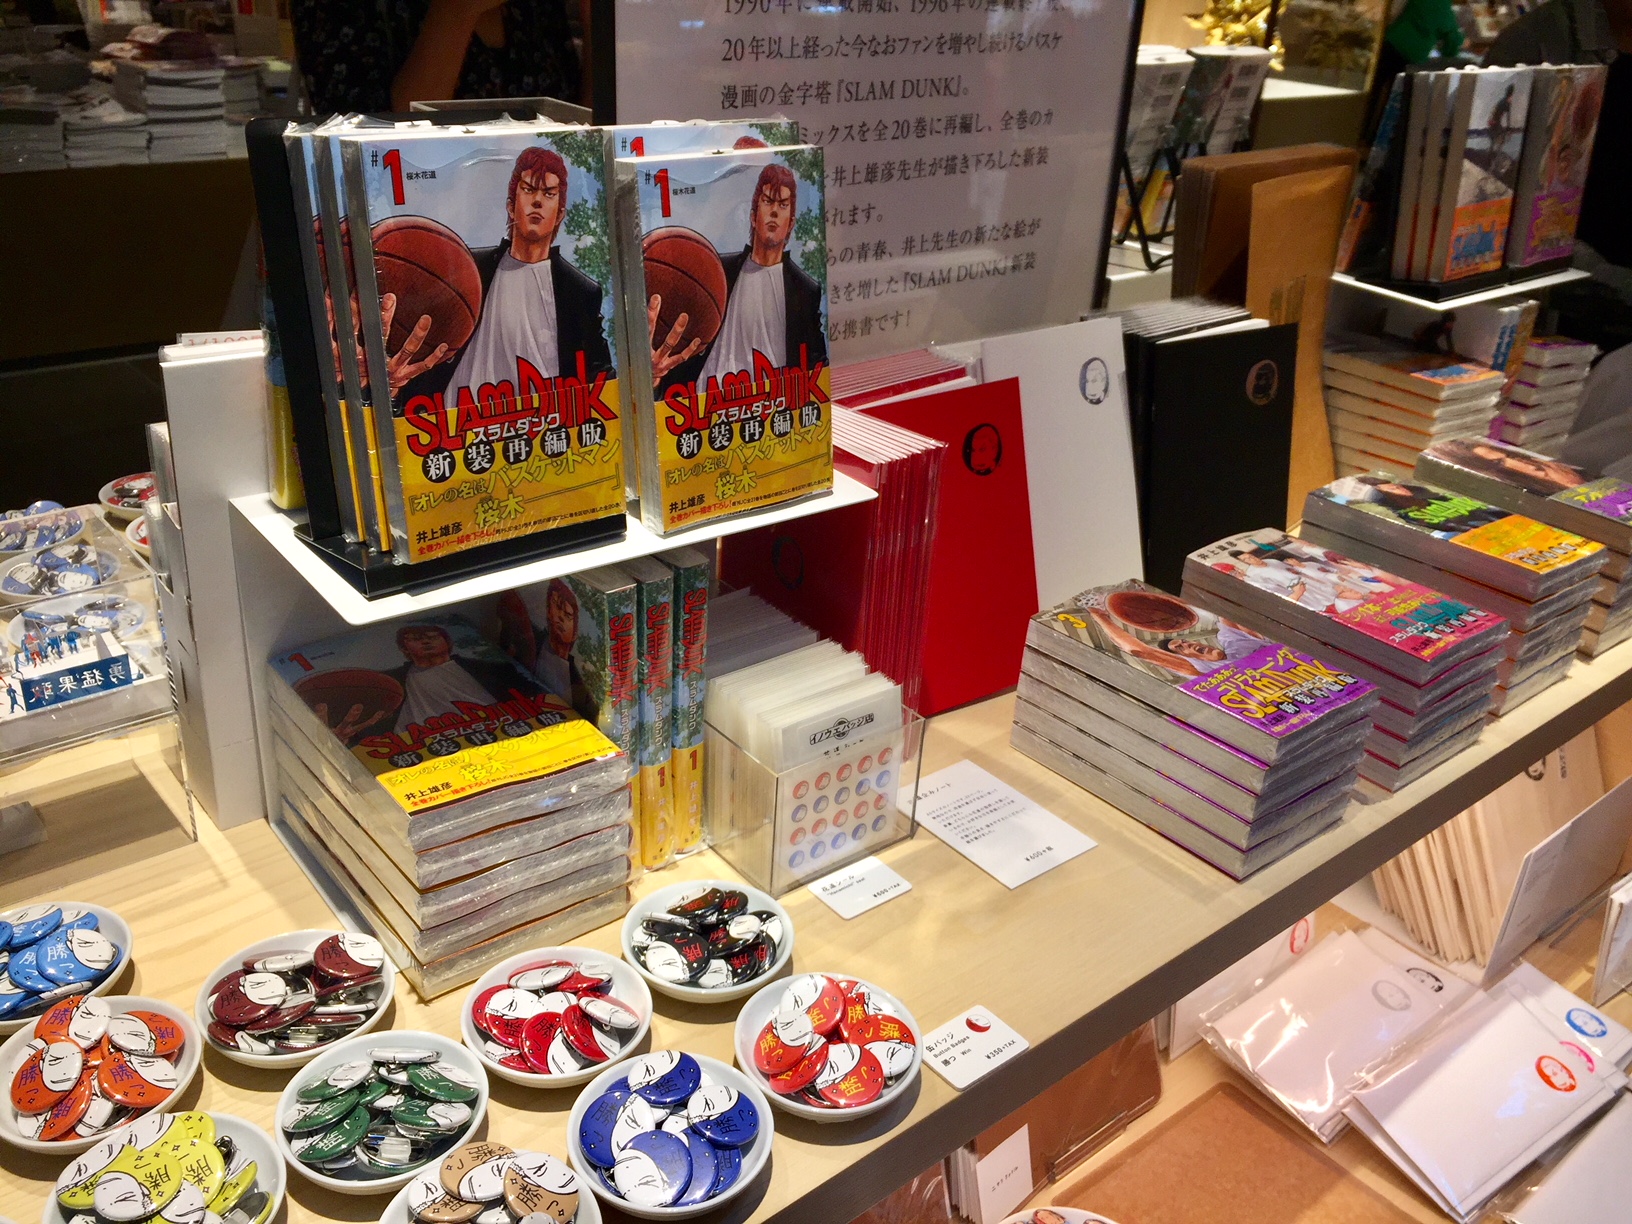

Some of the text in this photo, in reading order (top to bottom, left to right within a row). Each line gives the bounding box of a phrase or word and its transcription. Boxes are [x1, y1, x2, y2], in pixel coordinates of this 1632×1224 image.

[716, 396, 786, 424] スラムダンク
[473, 412, 560, 444] スラムダンク
[676, 401, 821, 459] 新装再編版
[422, 418, 606, 483] 新装再編版
[669, 493, 705, 514] 井上雄彦
[416, 521, 463, 544] 井上雄彦
[404, 781, 453, 801] 井上雄彦
